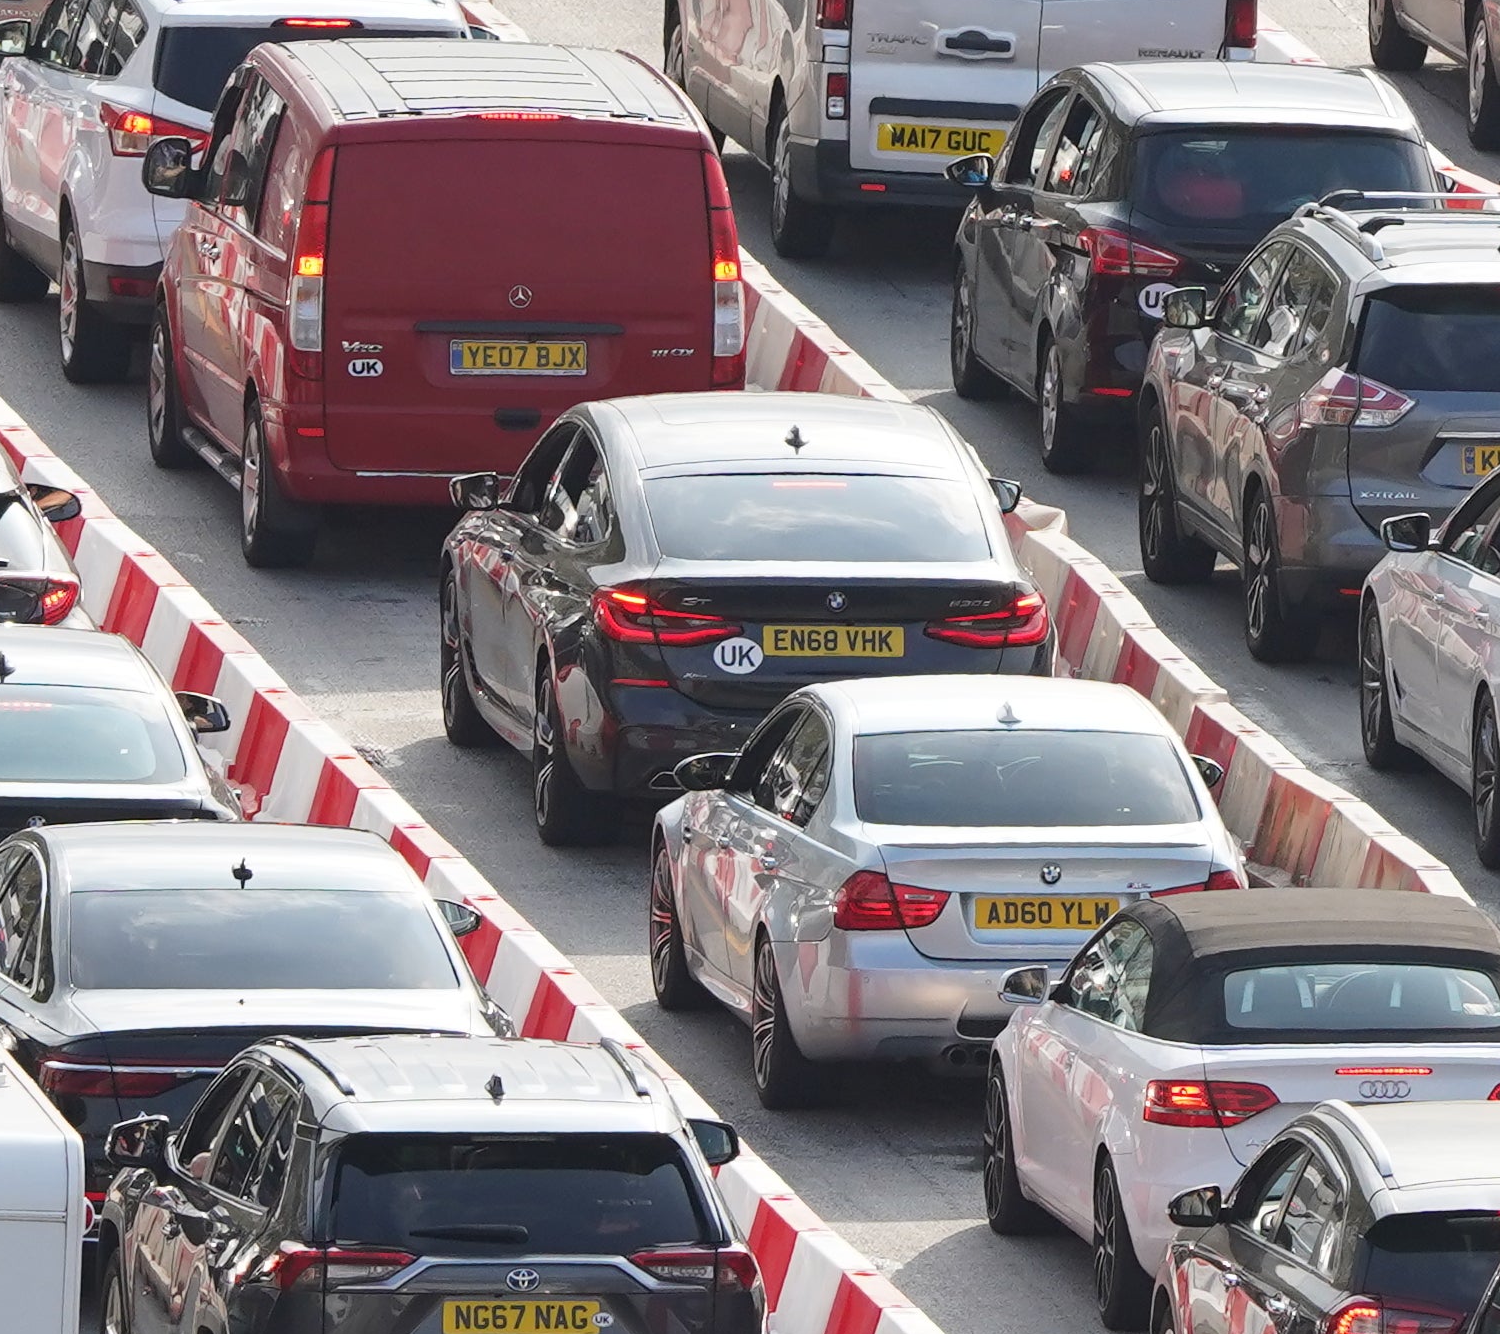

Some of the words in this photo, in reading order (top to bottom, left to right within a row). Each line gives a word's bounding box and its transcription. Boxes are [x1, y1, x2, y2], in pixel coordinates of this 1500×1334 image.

[1138, 47, 1204, 59] RENAULT
[890, 127, 940, 147] MA17
[946, 131, 992, 152] GUC
[352, 361, 379, 375] UK
[466, 346, 526, 368] YE07
[536, 347, 581, 369] BJX
[1359, 490, 1420, 501] X-TRAIL
[774, 629, 838, 651] EN68
[848, 631, 894, 653] VHK
[720, 645, 755, 667] UK
[987, 902, 1052, 925] AD60
[1061, 904, 1109, 926] YLW
[455, 1305, 525, 1330] NG67
[534, 1305, 588, 1331] NAG
[595, 1316, 610, 1324] UK
